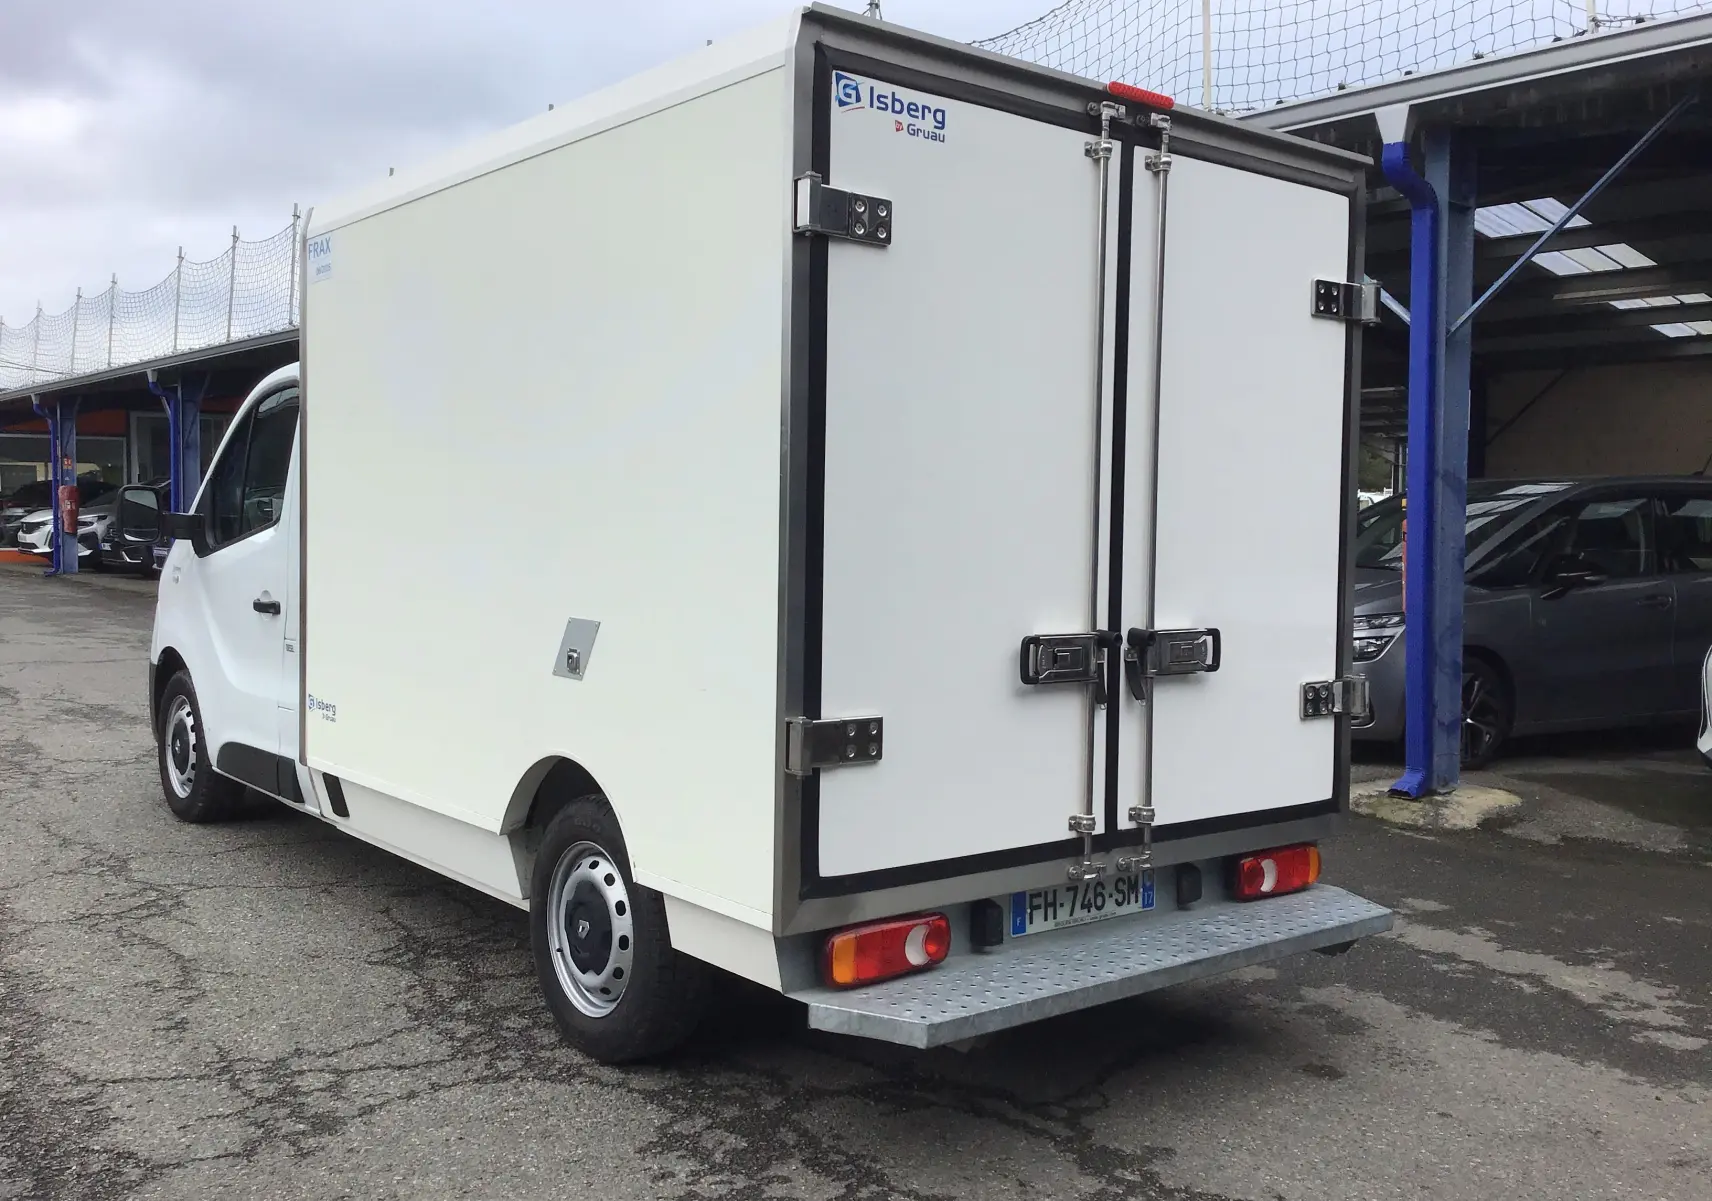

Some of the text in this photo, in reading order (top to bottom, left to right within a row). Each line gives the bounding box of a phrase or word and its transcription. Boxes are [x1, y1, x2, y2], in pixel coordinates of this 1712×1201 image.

[869, 86, 946, 130] Isberg
[907, 123, 945, 143] Gruau
[308, 236, 331, 261] FRAX
[316, 697, 336, 716] Isberg
[1016, 916, 1022, 927] F
[1029, 875, 1139, 925] FH-746-SM
[1144, 891, 1153, 905] 17
